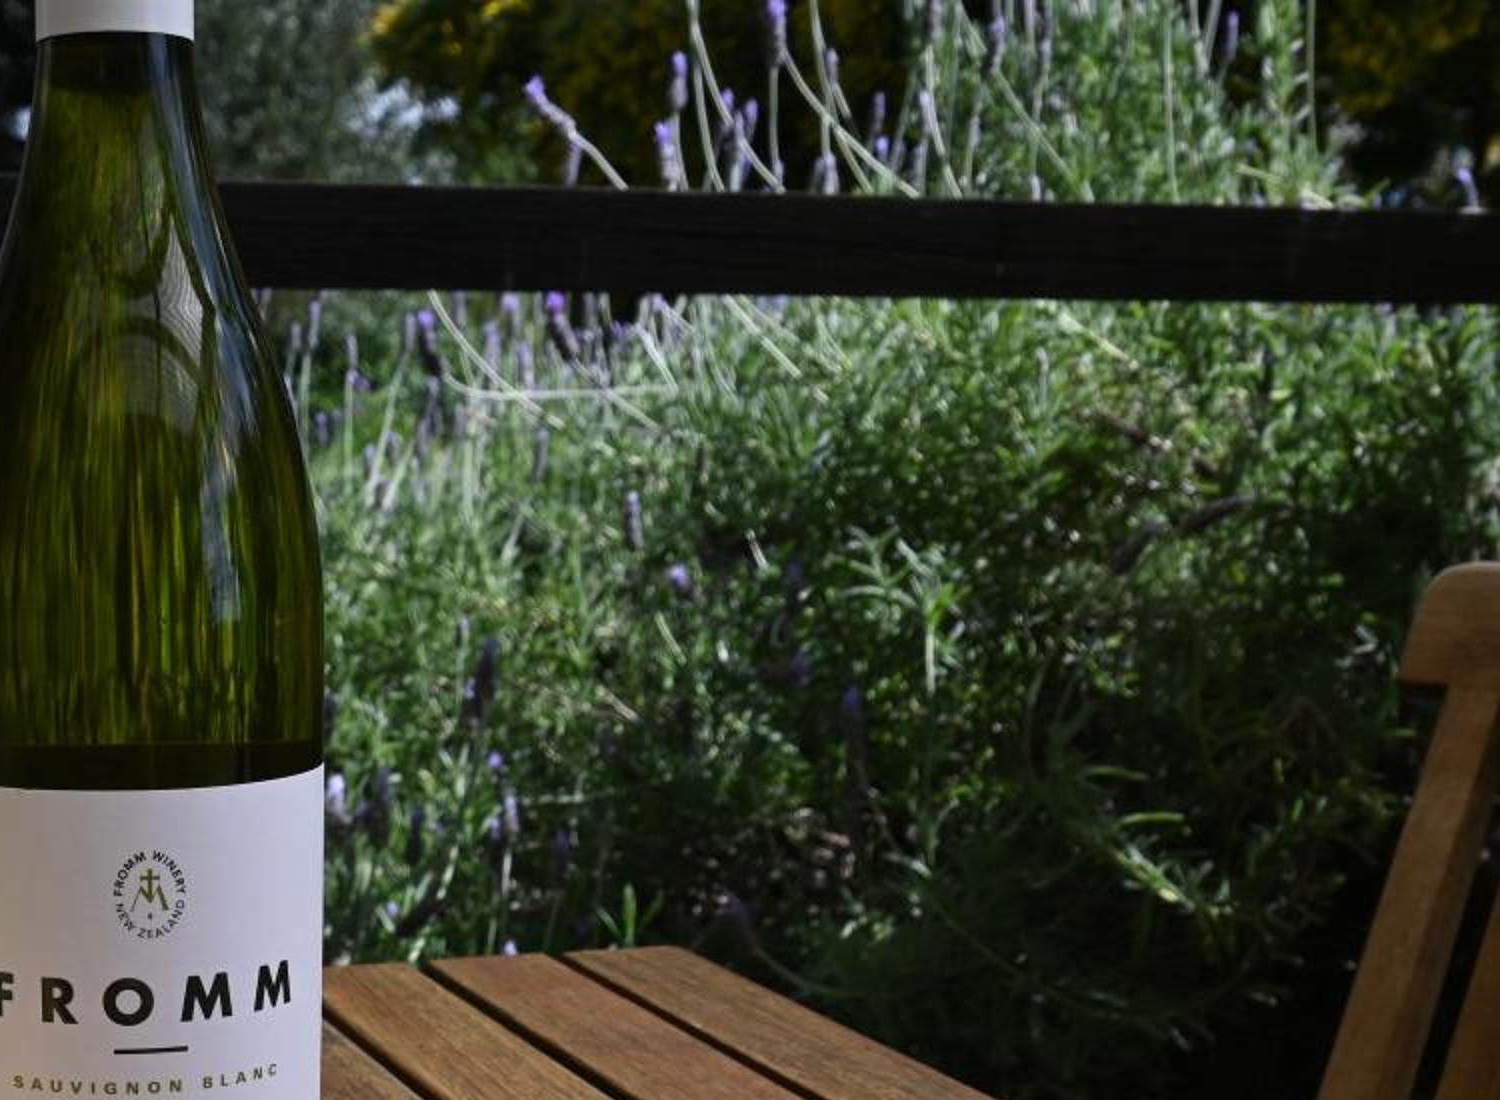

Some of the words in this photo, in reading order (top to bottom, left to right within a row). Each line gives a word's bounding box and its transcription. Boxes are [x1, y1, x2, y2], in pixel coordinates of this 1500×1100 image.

[113, 851, 147, 897] FROMM
[152, 850, 187, 895] WINERY
[115, 903, 137, 932] NEW
[137, 899, 186, 939] ZEALAND
[12, 1075, 183, 1096] SAUVIGNON
[202, 1063, 278, 1090] BLANC
